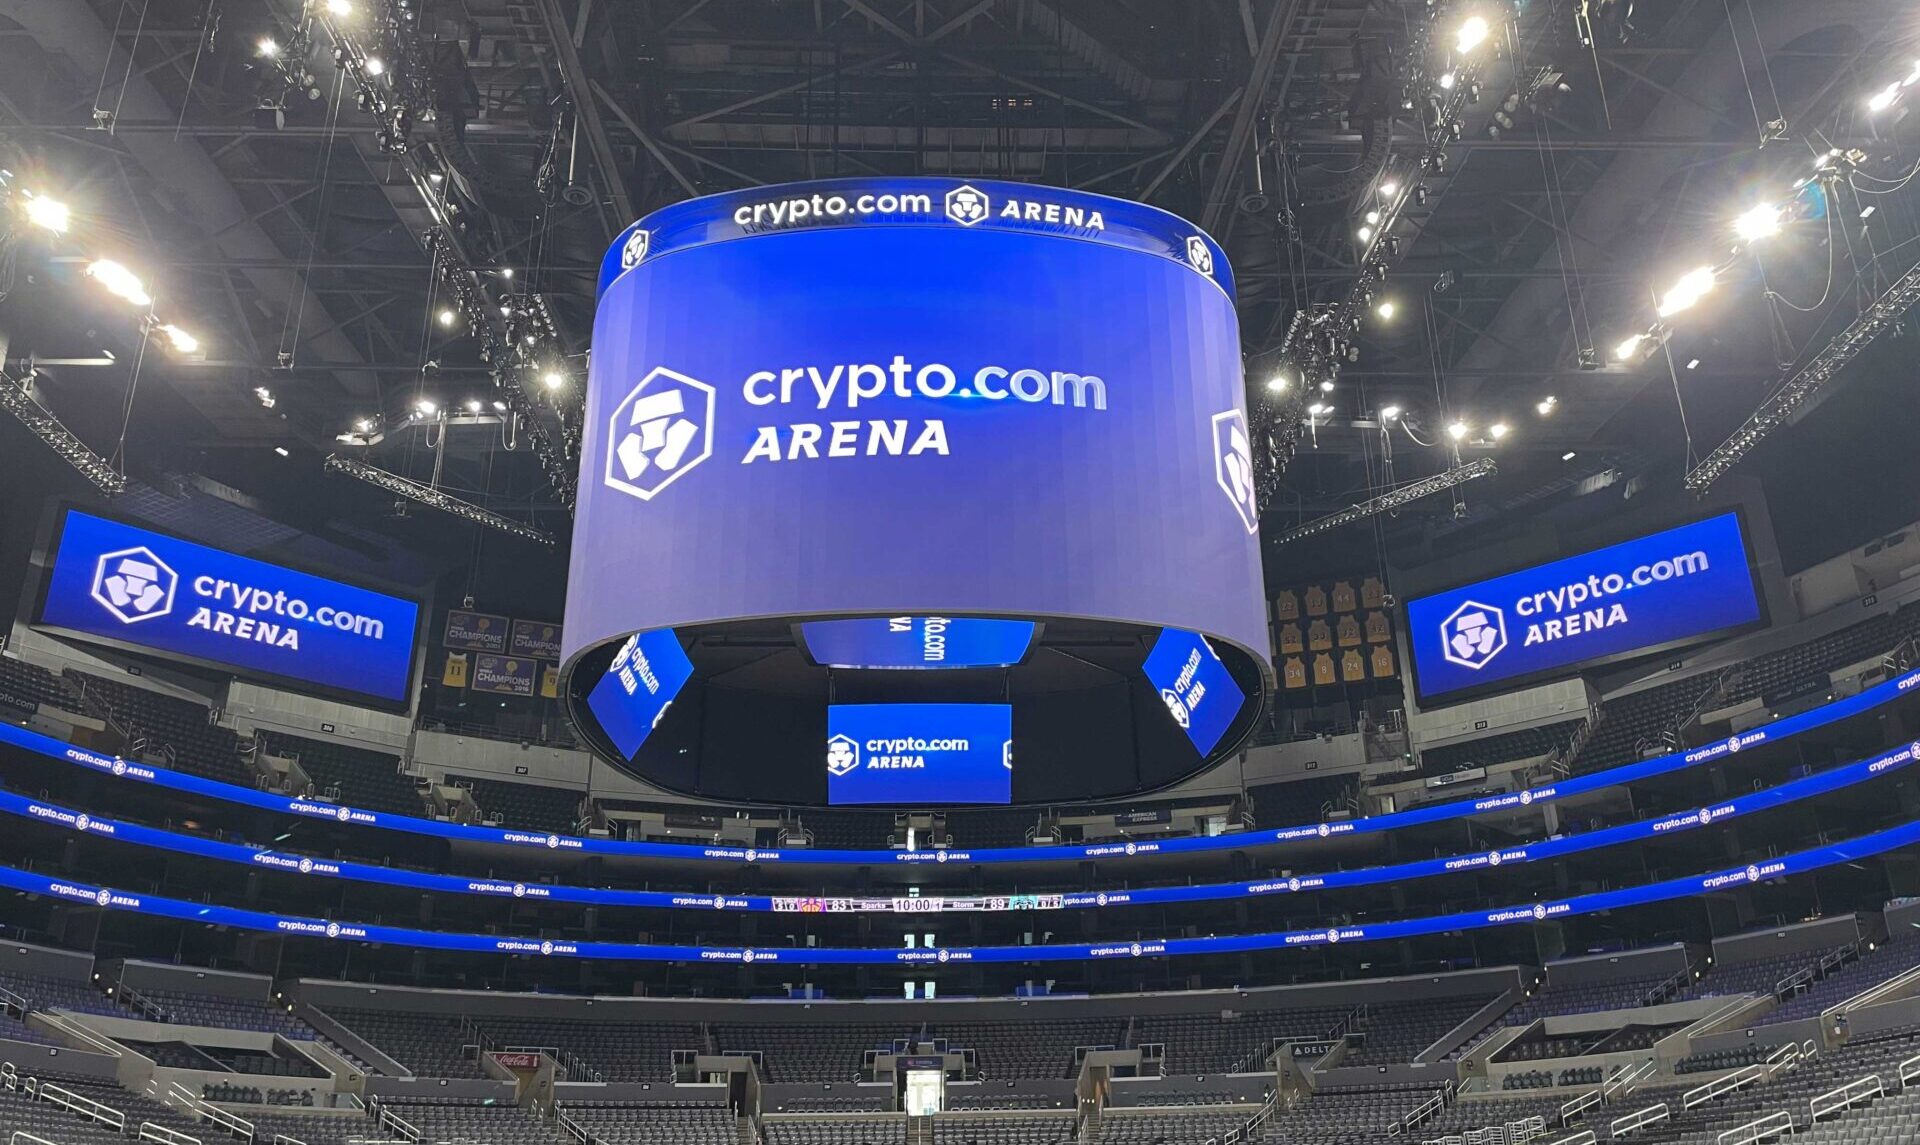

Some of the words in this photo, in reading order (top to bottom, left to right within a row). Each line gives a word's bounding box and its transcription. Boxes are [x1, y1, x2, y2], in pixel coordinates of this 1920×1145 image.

[734, 190, 931, 226] crypto.com
[1000, 200, 1106, 232] ARENA
[743, 355, 1107, 411] crypto.com
[741, 418, 950, 465] ARENA
[1516, 550, 1709, 617] crypto.com
[193, 575, 384, 640] crypto.com
[187, 606, 300, 652] ARENA
[1524, 603, 1629, 648] ARENA
[449, 630, 502, 644] CHAMPIONS
[631, 647, 660, 695] crypto.com
[1174, 647, 1202, 694] crypto.com
[1321, 666, 1327, 674] 8
[478, 672, 530, 686] CHAMPIONS
[618, 665, 638, 696] ARENA
[866, 736, 969, 753] crypto.com
[1686, 744, 1727, 762] crypto.com
[1741, 732, 1765, 745] ARENA
[67, 750, 111, 769] crypto.com
[127, 767, 154, 778] ARENA
[867, 755, 925, 769] ARENA
[1869, 750, 1910, 771] crypto.com
[1476, 796, 1518, 809] crypto.com
[1533, 788, 1555, 799] ARENA
[29, 806, 75, 823] crypto.com
[89, 821, 114, 832] ARENA
[290, 802, 336, 816] crypto.com
[351, 812, 375, 822] ARENA
[1654, 816, 1698, 830] crypto.com
[1712, 806, 1734, 817] ARENA
[1278, 827, 1317, 838] crypto.com
[1331, 824, 1353, 833] ARENA
[504, 833, 546, 844] crypto.com
[560, 839, 582, 848] ARENA
[705, 849, 744, 858] crypto.com
[897, 853, 935, 861] crypto.com
[1086, 846, 1124, 856] crypto.com
[1137, 844, 1158, 852] ARENA
[255, 855, 298, 867] crypto.com
[313, 863, 338, 873] ARENA
[1446, 855, 1487, 868] crypto.com
[1502, 850, 1526, 861] ARENA
[1704, 872, 1746, 887] crypto.com
[1760, 863, 1785, 874] ARENA
[469, 883, 512, 893] crypto.com
[526, 888, 549, 896] ARENA
[1249, 881, 1288, 892] crypto.com
[1301, 878, 1323, 887] ARENA
[51, 884, 96, 899] crypto.com
[111, 895, 139, 906] ARENA
[673, 897, 712, 906] crypto.com
[832, 901, 846, 910] 83
[861, 902, 886, 910] Sparks
[896, 900, 930, 911] 10:00
[990, 899, 1004, 909] 89
[1488, 909, 1532, 921] crypto.com
[1547, 904, 1569, 915] ARENA
[279, 921, 325, 932] crypto.com
[340, 927, 365, 937] ARENA
[1286, 932, 1326, 943] crypto.com
[1340, 930, 1363, 938] ARENA
[497, 941, 540, 951] crypto.com
[554, 945, 576, 953] ARENA
[702, 951, 741, 959] crypto.com
[1091, 947, 1129, 956] crypto.com
[1143, 945, 1164, 953] ARENA
[898, 952, 936, 961] crypto.com
